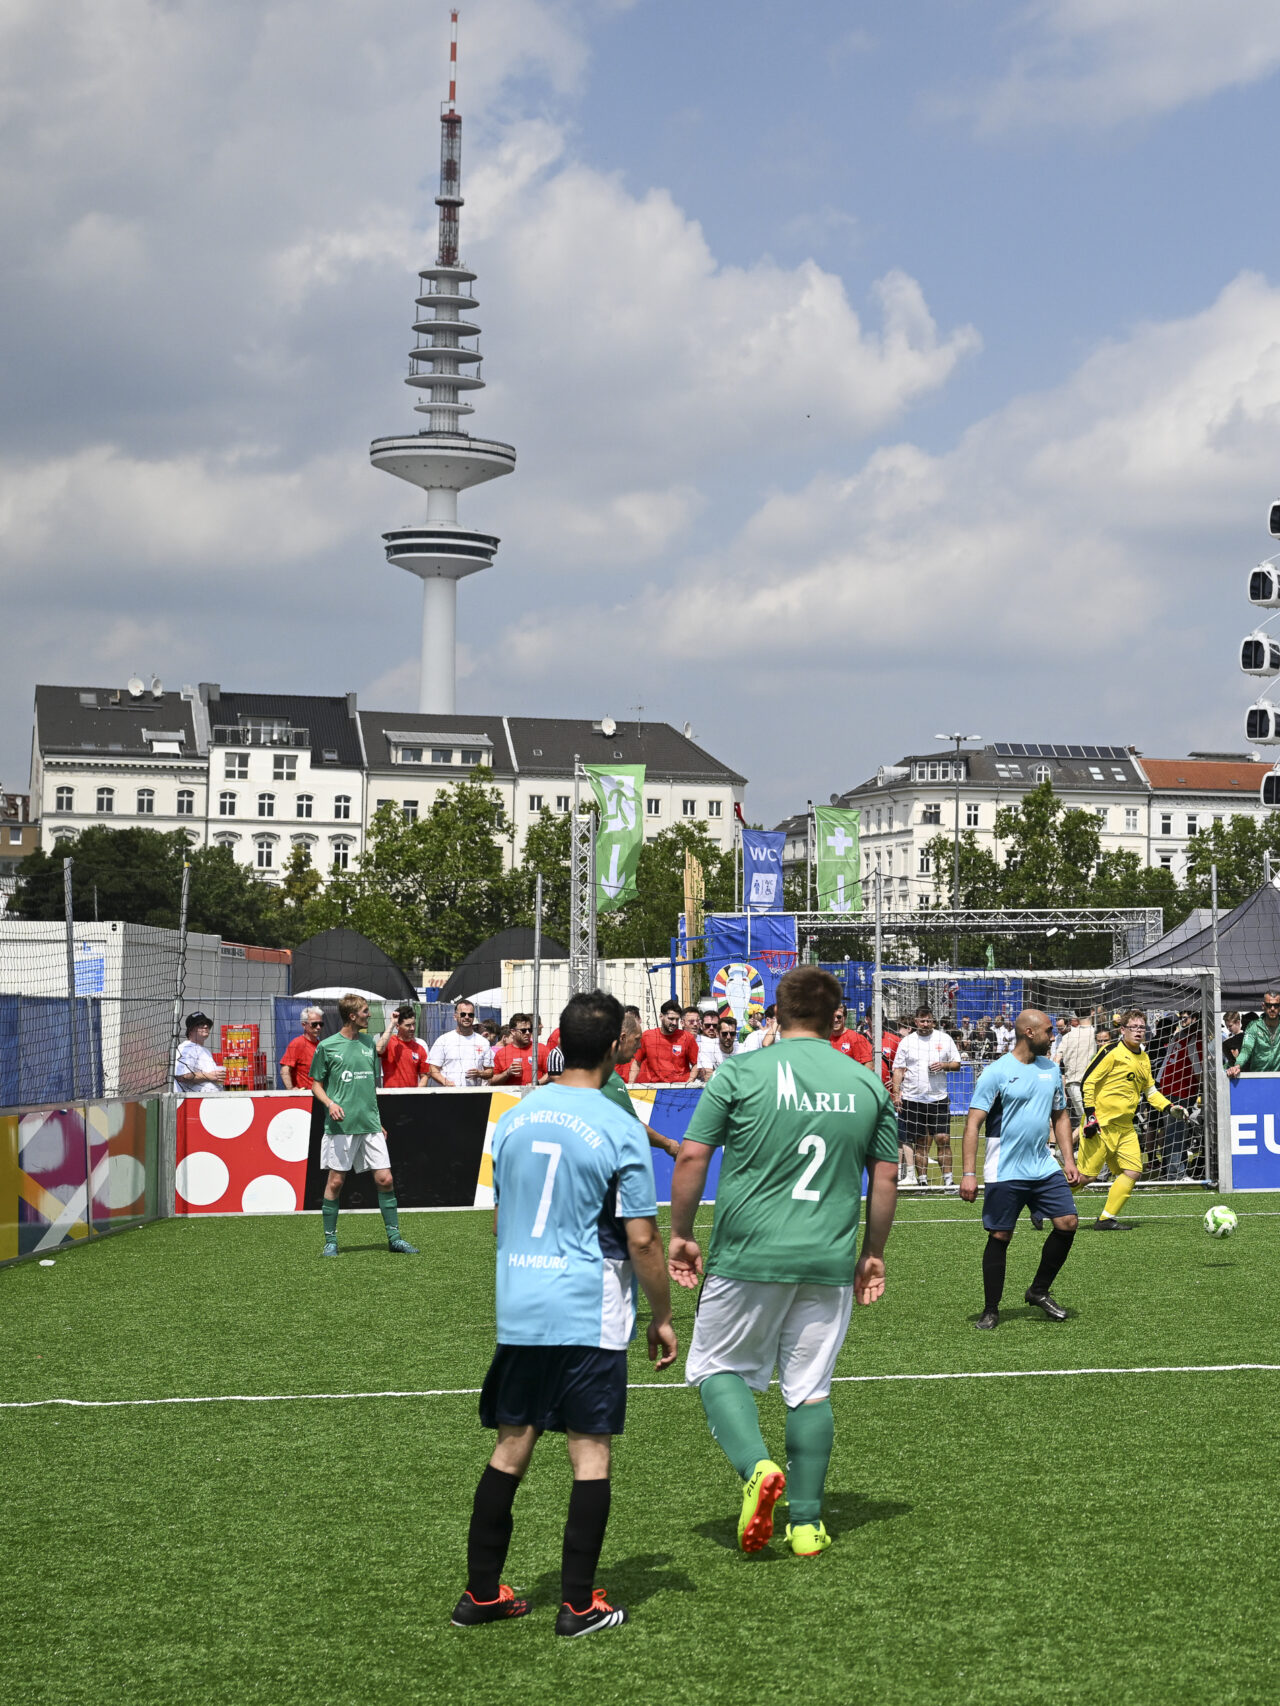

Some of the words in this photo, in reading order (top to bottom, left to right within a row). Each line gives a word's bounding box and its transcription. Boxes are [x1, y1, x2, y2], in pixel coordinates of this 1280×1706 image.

[749, 846, 778, 862] WC
[776, 1060, 857, 1113] MARLI
[791, 1134, 827, 1202] 2
[531, 1140, 562, 1238] 7
[508, 1252, 569, 1269] HAMBURG
[746, 1471, 763, 1497] FILA
